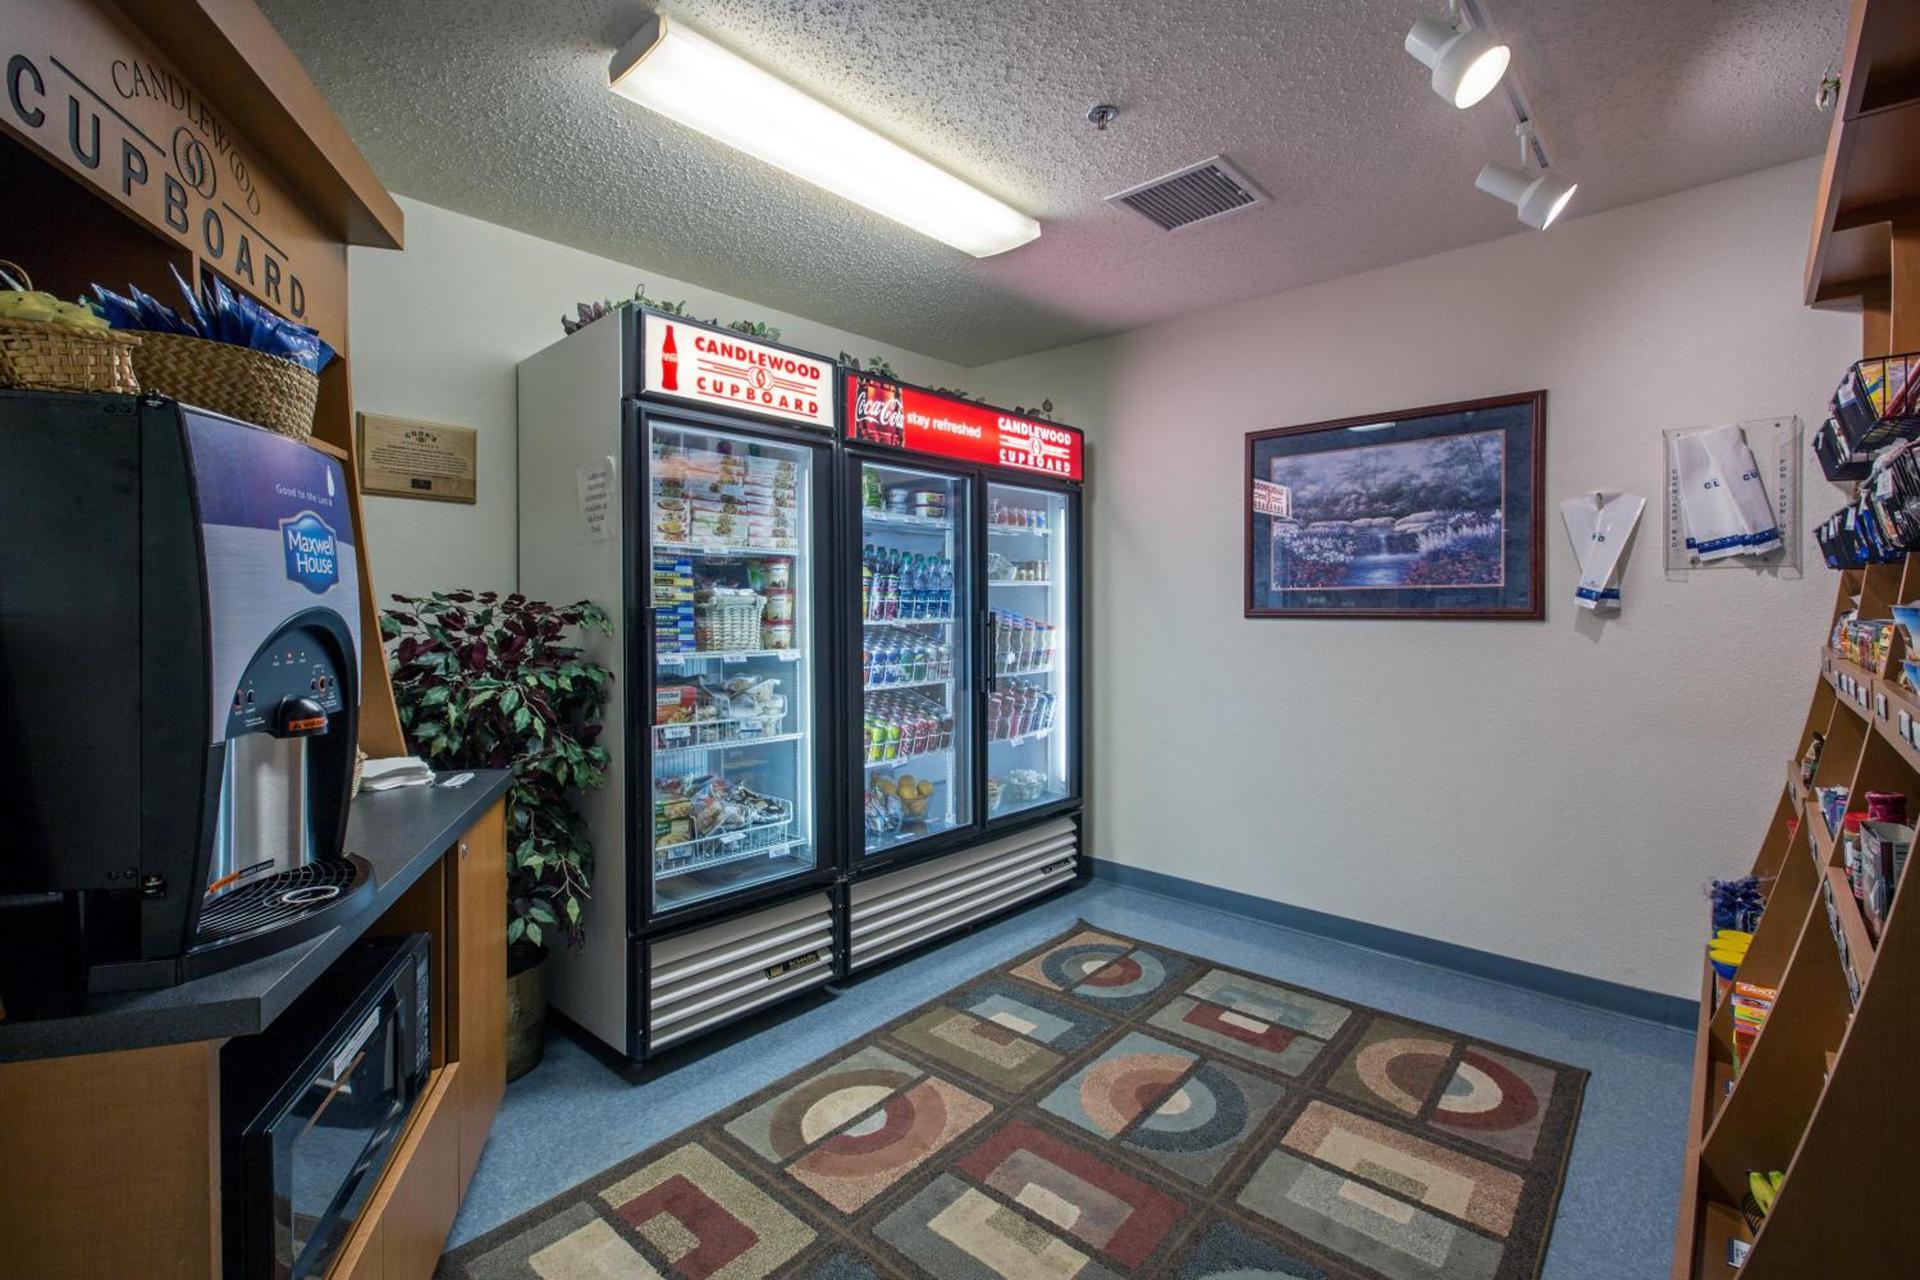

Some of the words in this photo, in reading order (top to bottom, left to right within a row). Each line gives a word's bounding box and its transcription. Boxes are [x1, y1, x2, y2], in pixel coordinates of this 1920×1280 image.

[111, 60, 261, 216] CANDLEWOOD
[6, 54, 306, 319] CUPBOARD
[695, 336, 820, 380] CANDLEWOOD
[696, 376, 818, 414] CUPBOARD
[855, 391, 904, 429] Coca-Cola
[906, 411, 930, 430] stay
[932, 417, 982, 439] refreshed
[998, 416, 1072, 445] CANDLEWOOD
[999, 448, 1071, 473] CUPBOARD
[275, 483, 297, 498] Good
[297, 490, 306, 500] to
[306, 491, 318, 504] the
[288, 529, 334, 556] Maxwell
[296, 552, 333, 574] House
